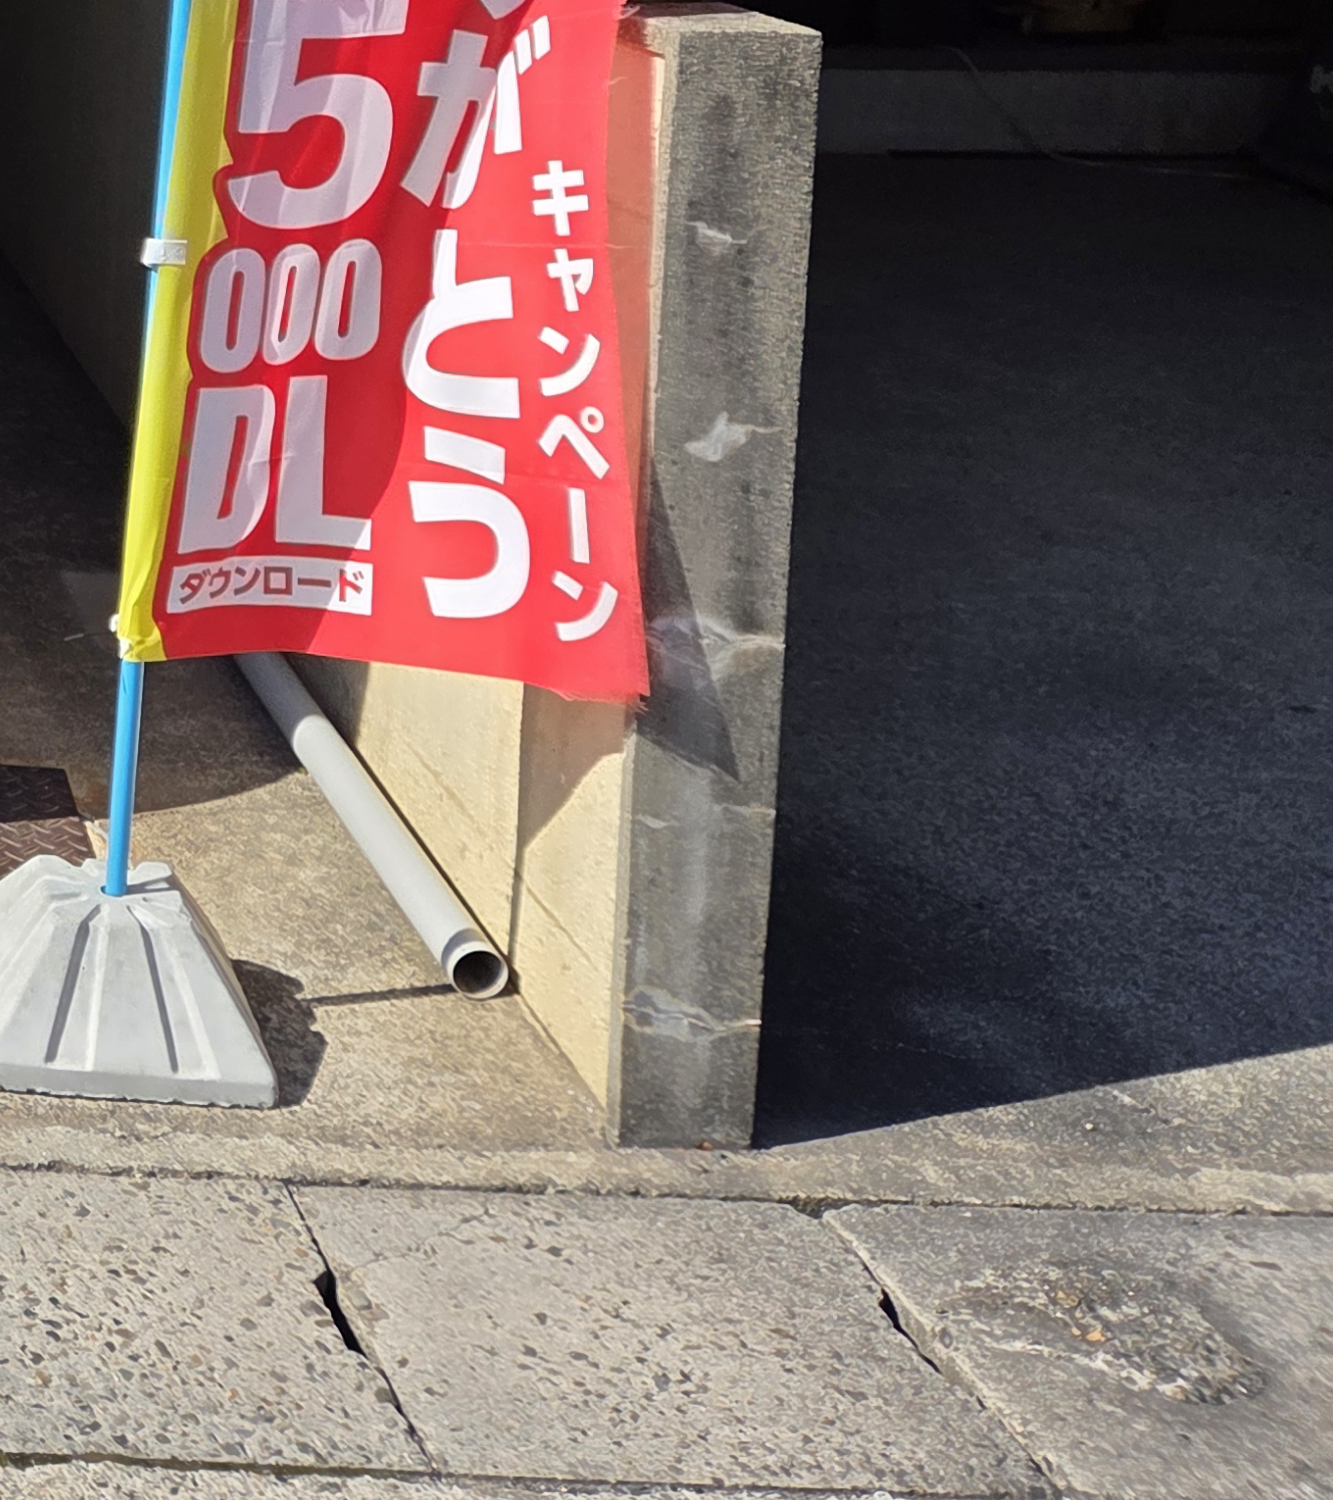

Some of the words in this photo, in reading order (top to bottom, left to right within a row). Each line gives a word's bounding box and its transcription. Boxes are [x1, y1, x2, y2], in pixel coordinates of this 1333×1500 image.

[177, 375, 372, 554] DL
[533, 160, 618, 642] キャンペーン
[177, 567, 366, 605] ダウンロード
